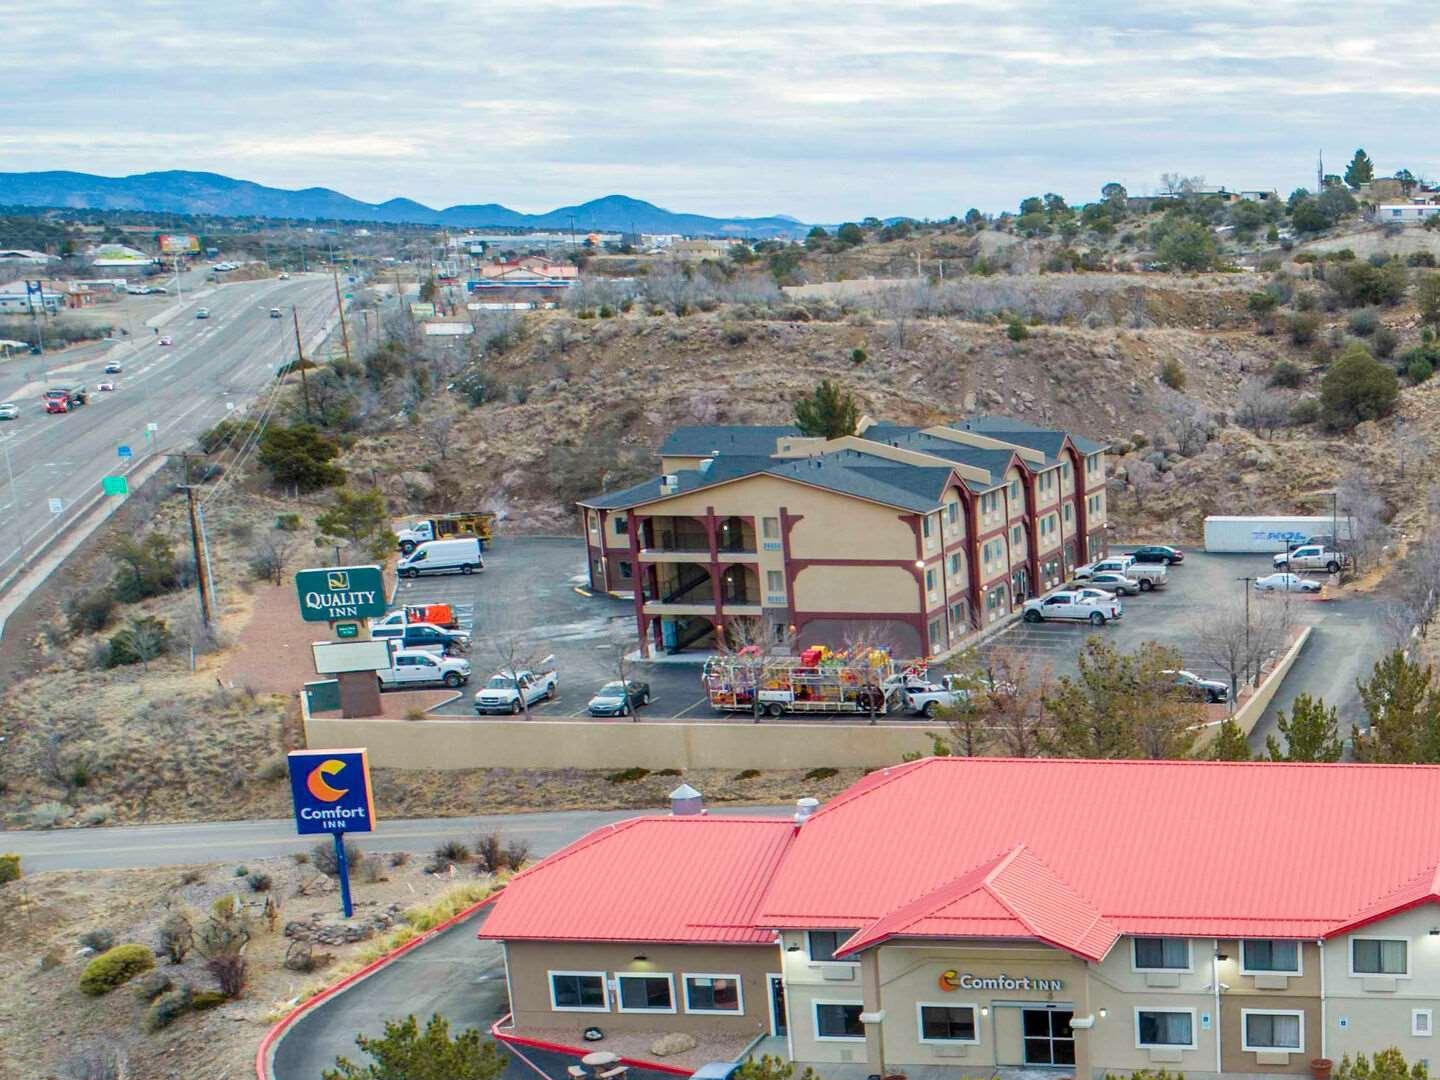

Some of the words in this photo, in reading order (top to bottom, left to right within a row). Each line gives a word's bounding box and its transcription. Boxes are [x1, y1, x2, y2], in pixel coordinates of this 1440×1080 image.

[305, 591, 376, 609] QUALITY
[329, 606, 358, 617] INN
[300, 806, 366, 819] Comfort
[323, 820, 347, 829] INN
[960, 974, 1030, 990] Comfort
[1033, 978, 1062, 990] INN
